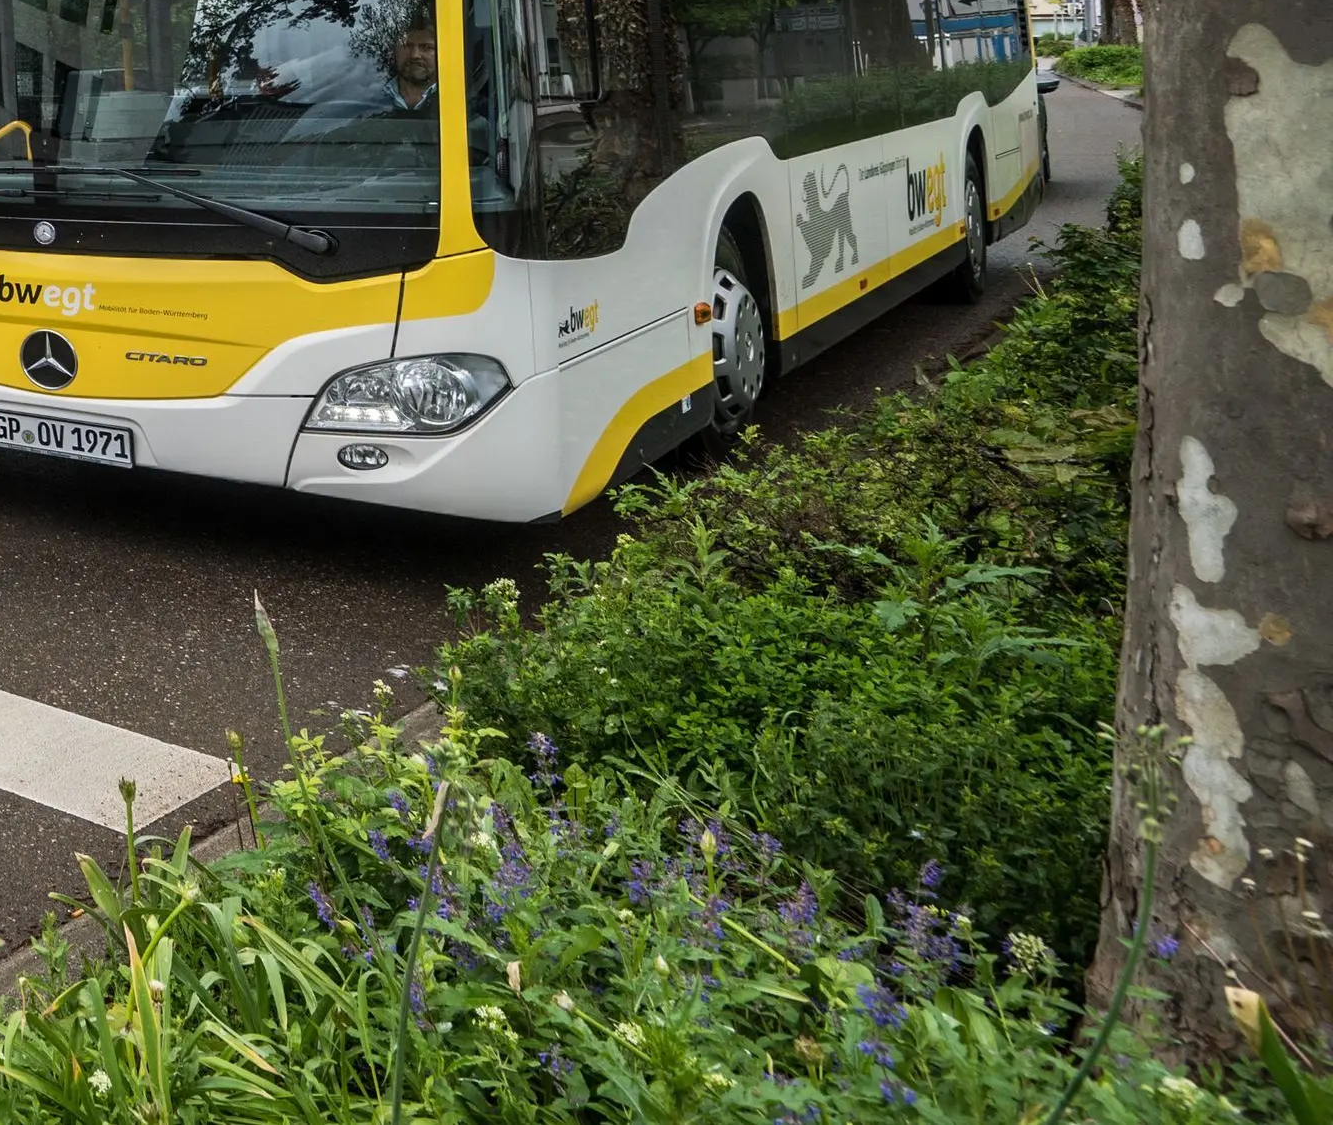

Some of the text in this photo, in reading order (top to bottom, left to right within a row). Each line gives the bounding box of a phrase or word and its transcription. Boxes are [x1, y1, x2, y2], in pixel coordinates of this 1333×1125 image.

[906, 150, 947, 227] bwegt
[98, 304, 208, 321] Mobilität für Baden-Württemberg
[569, 299, 599, 332] bwegt
[125, 351, 208, 366] CITARO
[37, 421, 65, 449] OV
[71, 426, 129, 460] 1971
